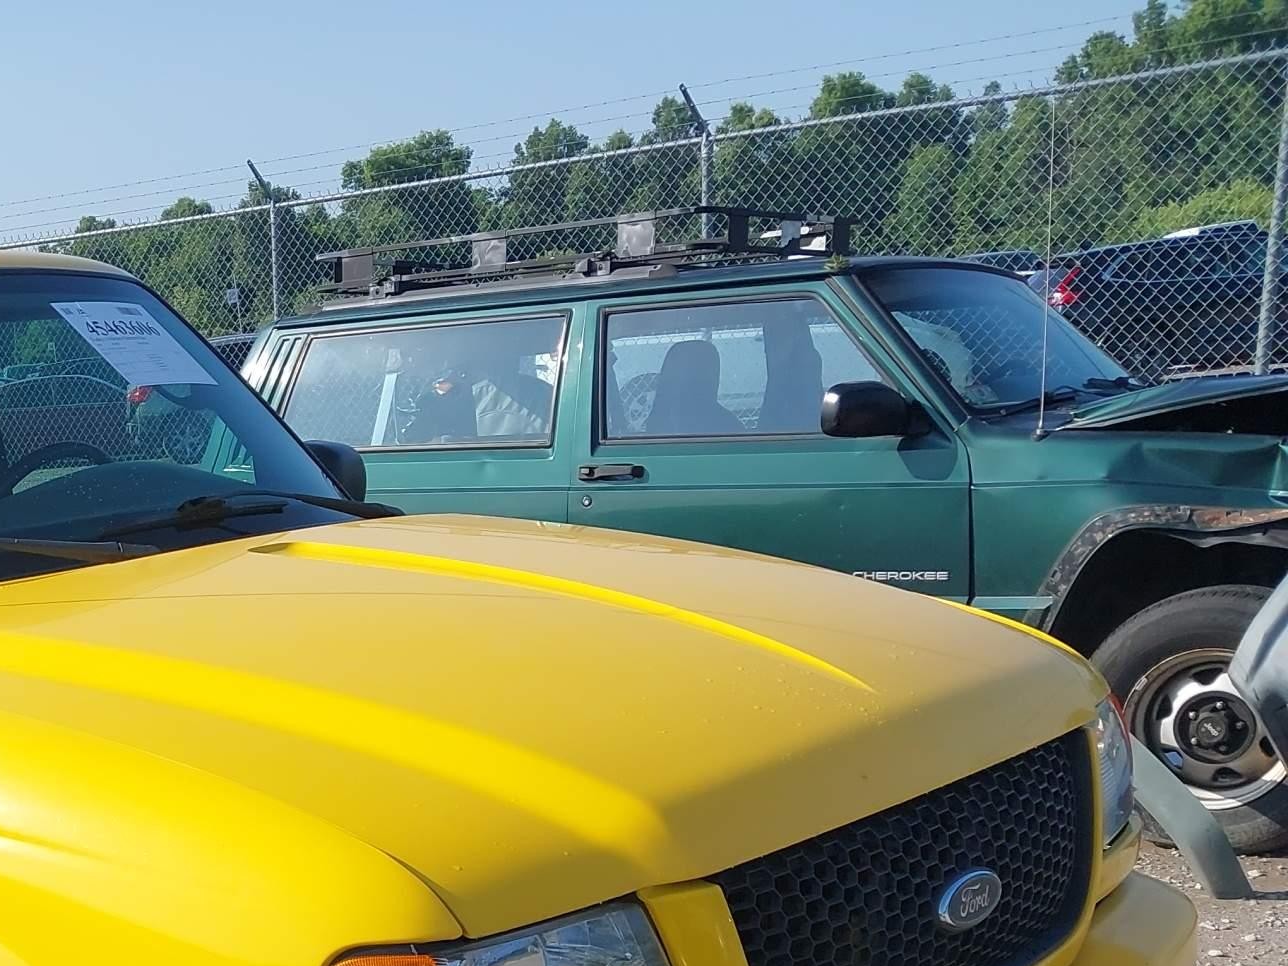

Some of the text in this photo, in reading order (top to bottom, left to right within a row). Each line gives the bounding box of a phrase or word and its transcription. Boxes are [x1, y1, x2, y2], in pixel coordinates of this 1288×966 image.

[85, 320, 161, 337] 45463606
[852, 571, 949, 581] CHEROKEE
[960, 882, 990, 918] Ford
